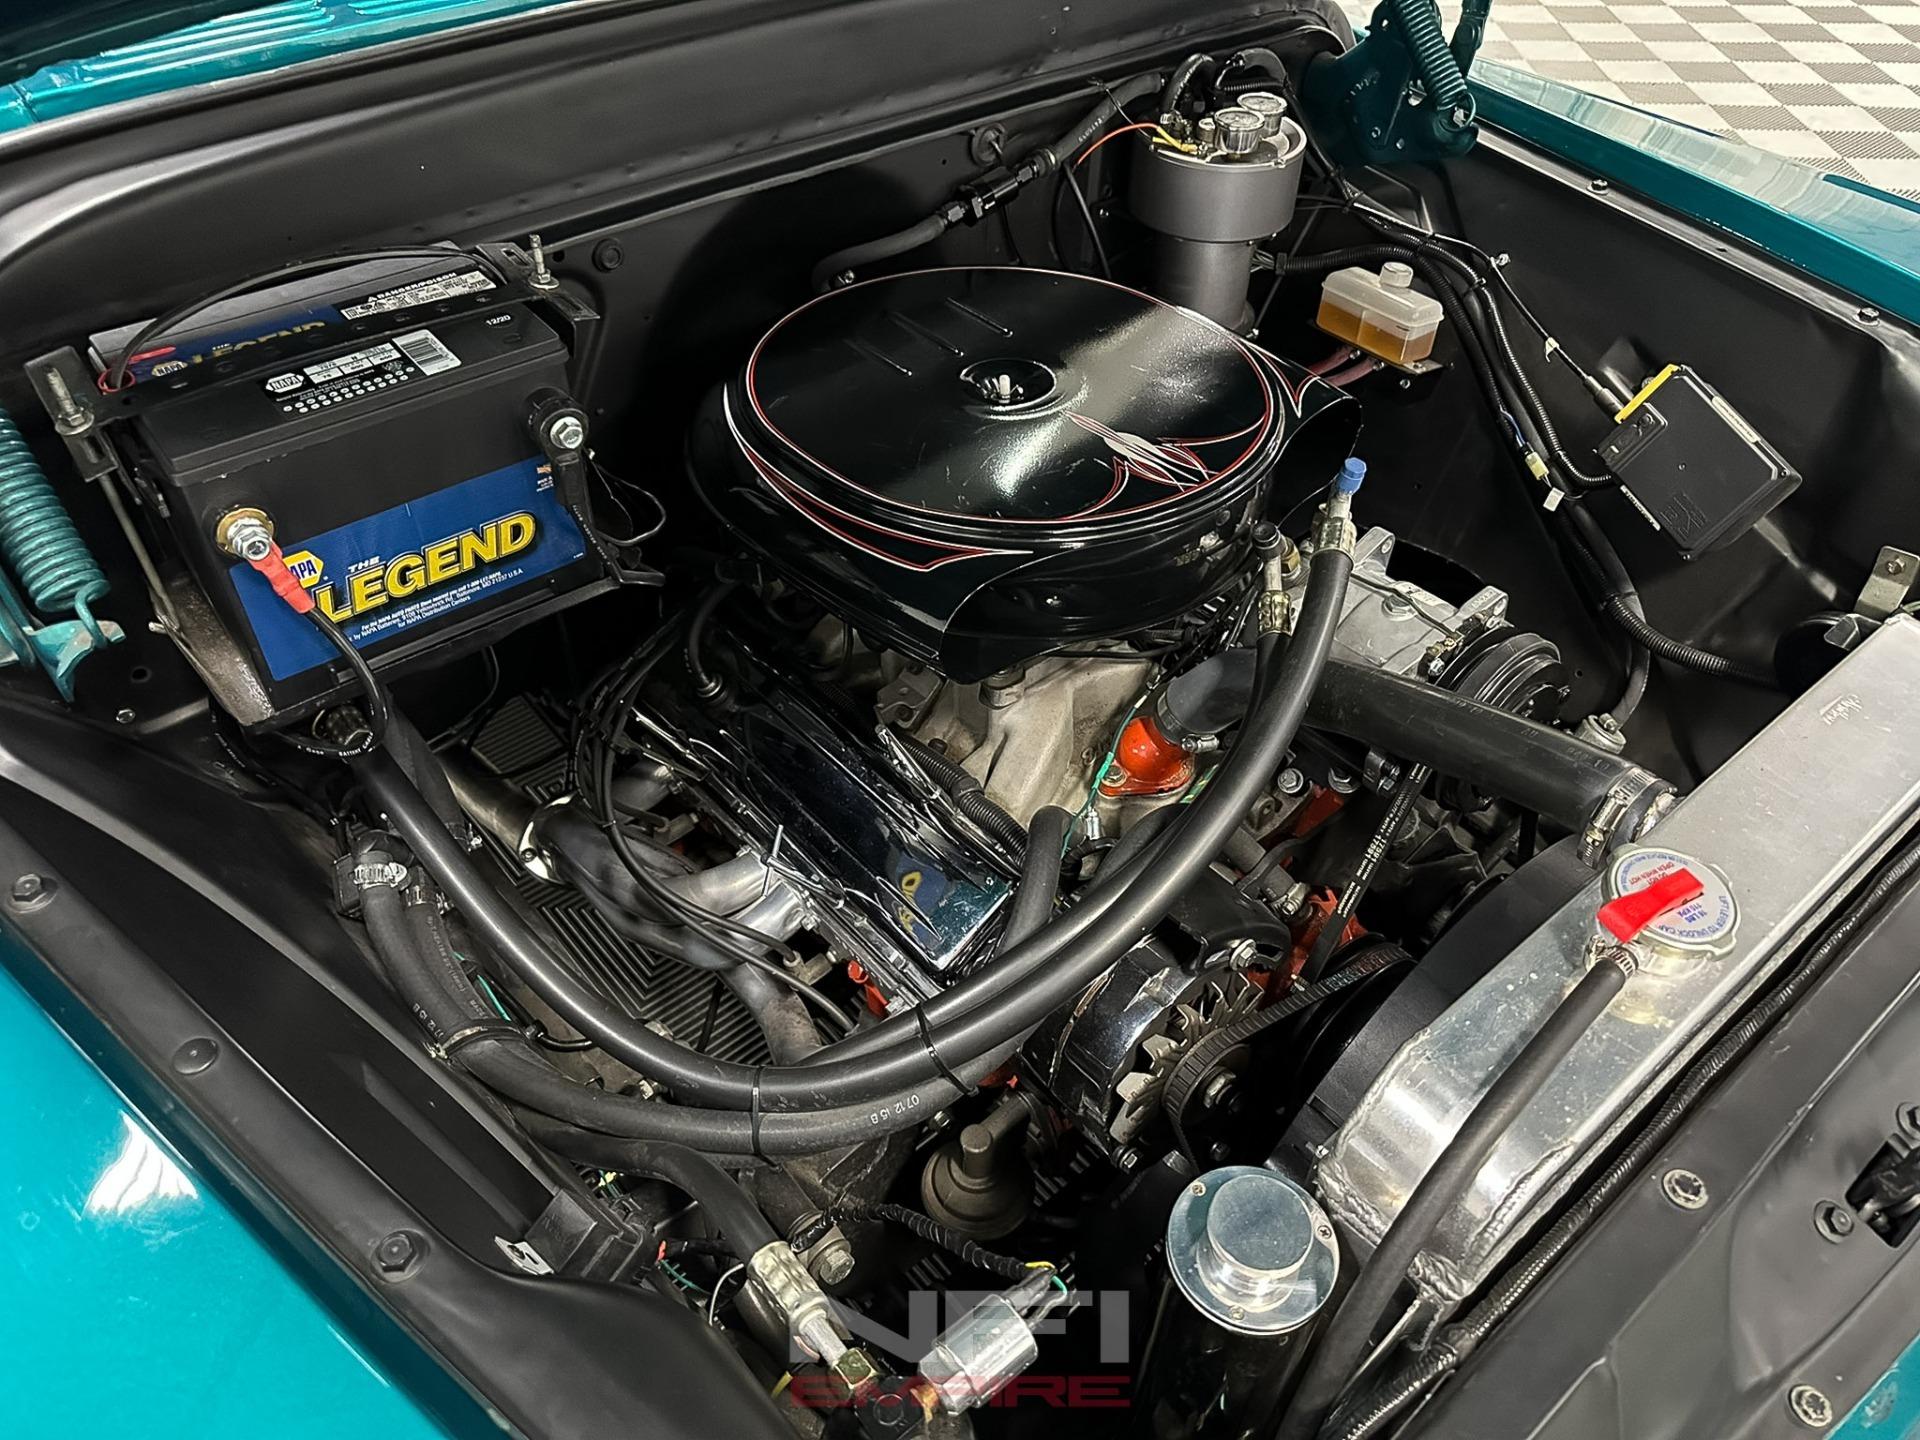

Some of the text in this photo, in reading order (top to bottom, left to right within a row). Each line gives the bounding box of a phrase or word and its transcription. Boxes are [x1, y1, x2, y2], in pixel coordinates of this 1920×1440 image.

[376, 272, 458, 299] DANGER/POISON
[157, 362, 183, 376] NAPA
[272, 376, 300, 392] NAPA
[290, 558, 317, 580] APA
[313, 510, 537, 624] LEGEND
[347, 555, 382, 573] THE
[407, 615, 422, 625] NAPA
[422, 601, 451, 618] Distribution
[451, 595, 471, 607] Centers
[361, 627, 377, 637] NAPA
[1640, 867, 1659, 879] WHEN
[1657, 861, 1675, 872] OPEN
